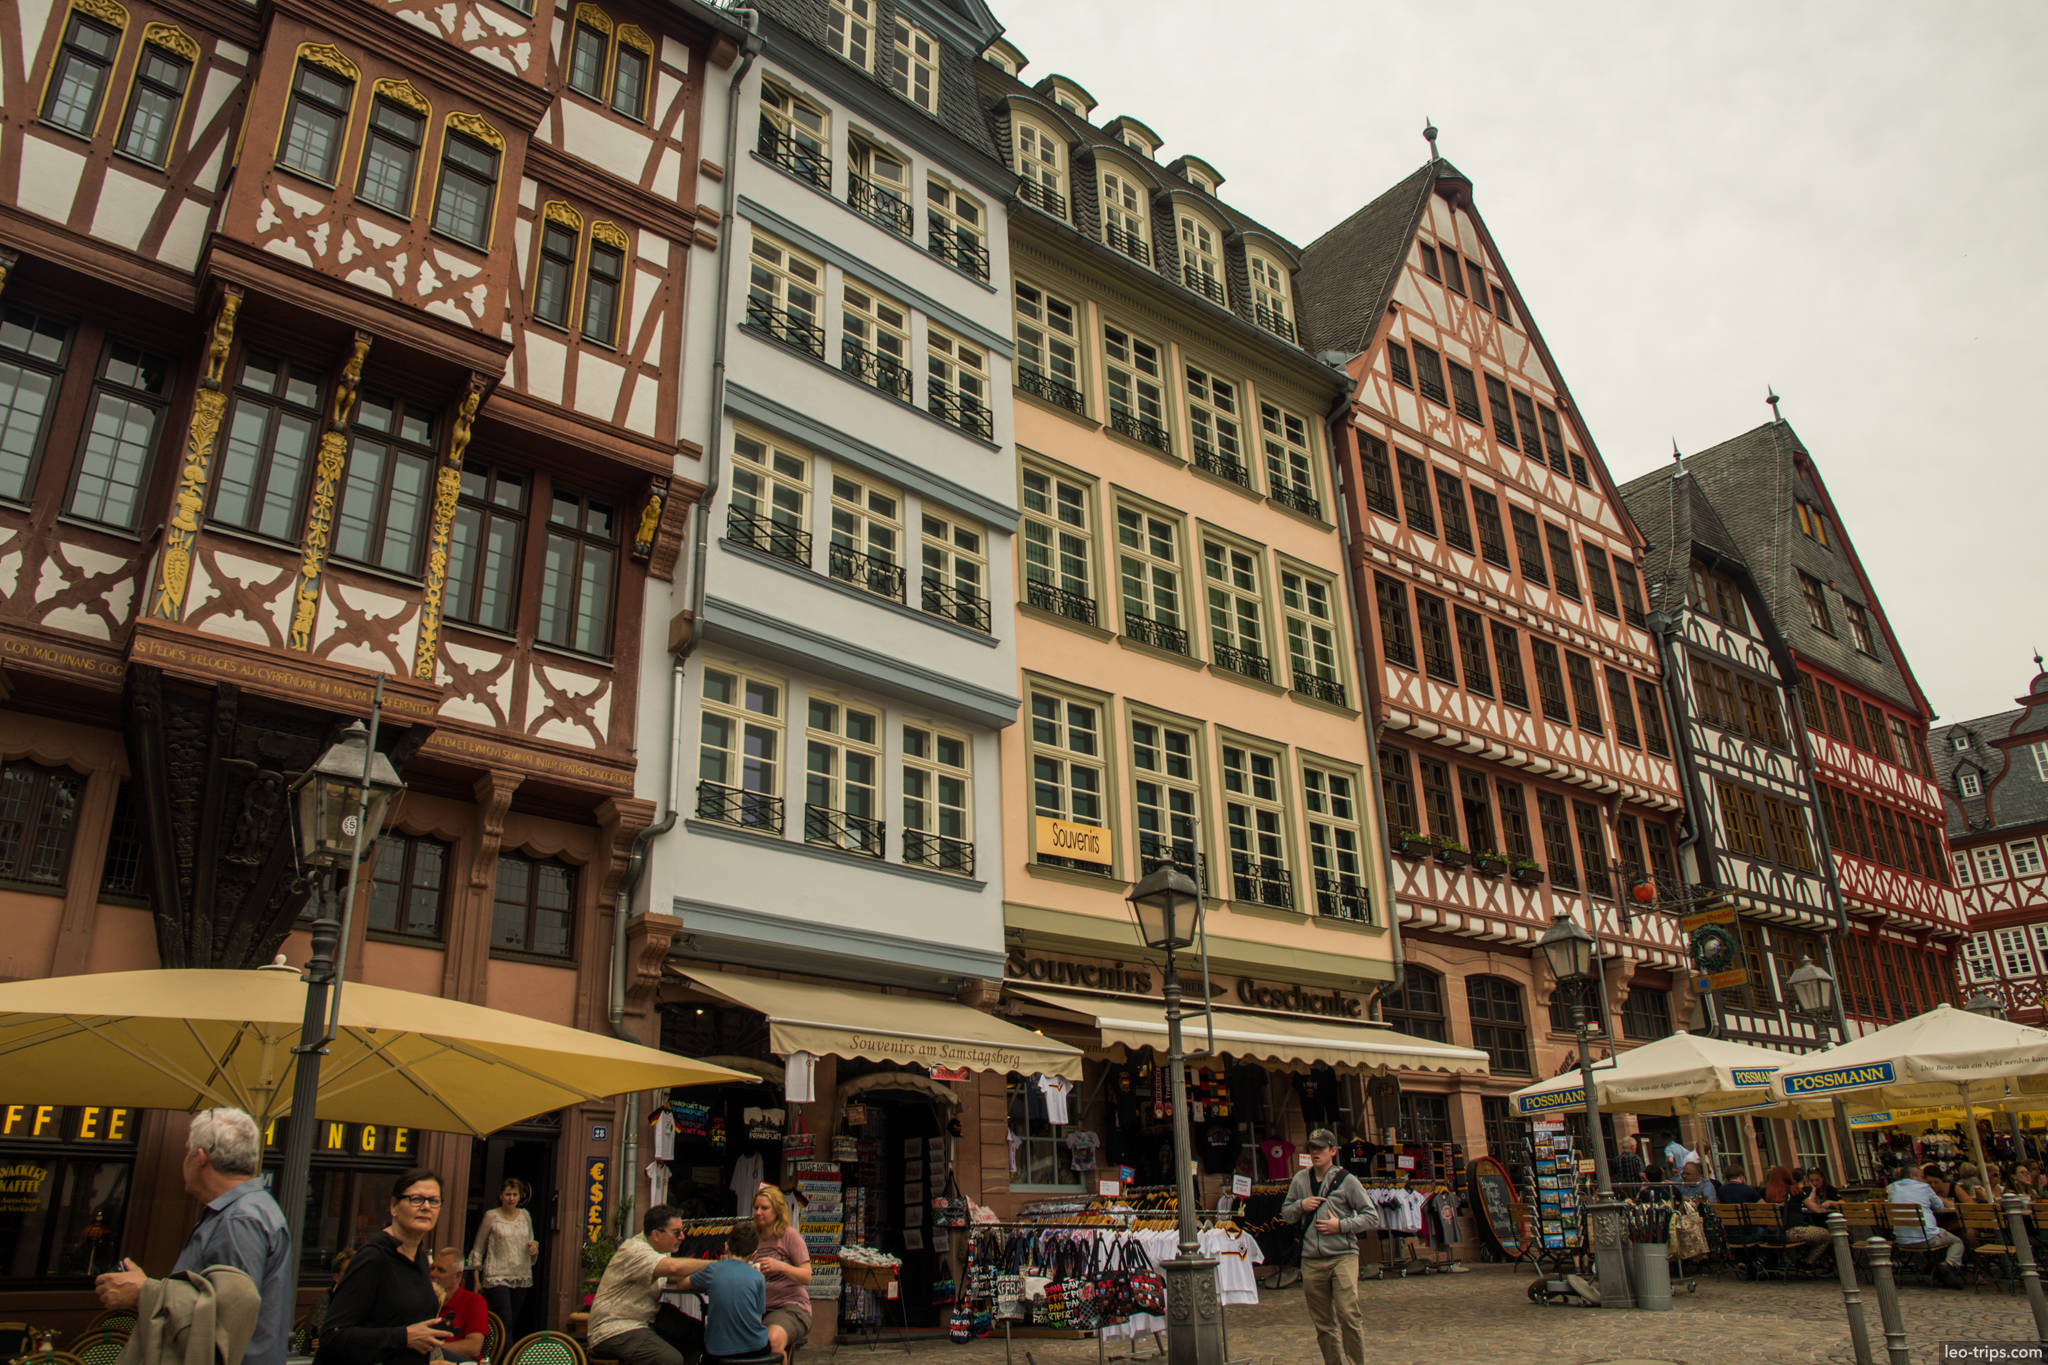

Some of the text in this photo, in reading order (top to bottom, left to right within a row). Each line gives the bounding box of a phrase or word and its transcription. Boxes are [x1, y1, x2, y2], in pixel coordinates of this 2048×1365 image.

[4, 639, 29, 656] COR
[32, 646, 97, 670] MACHINANS
[150, 640, 187, 661] PEDES
[190, 653, 237, 672] VELOCES
[240, 665, 256, 676] AD
[257, 667, 317, 690] CVRRENDVM
[320, 683, 330, 693] IN
[333, 685, 367, 702] MALVM
[502, 749, 533, 765] SEMINAT
[536, 757, 558, 770] INTER
[559, 761, 590, 777] FRATRES
[589, 768, 634, 787] DISCORDIAS
[1052, 822, 1100, 854] Souvenirs
[1007, 948, 1153, 994] Souvenirs
[1237, 977, 1363, 1018] Geschenke
[849, 1035, 1021, 1069] Souvenirs am Samstagsberg
[1936, 1063, 1955, 1071] Beste
[1984, 1058, 2003, 1070] Apfel
[2004, 1057, 2030, 1065] werden
[1627, 1085, 1640, 1093] Beste
[1660, 1081, 1674, 1091] Apfel
[1792, 1066, 1885, 1091] POSSMANN
[800, 1163, 832, 1172] AUSFAHRT
[800, 1224, 840, 1233] FRANKFURT
[811, 1267, 840, 1276] SFAHRT
